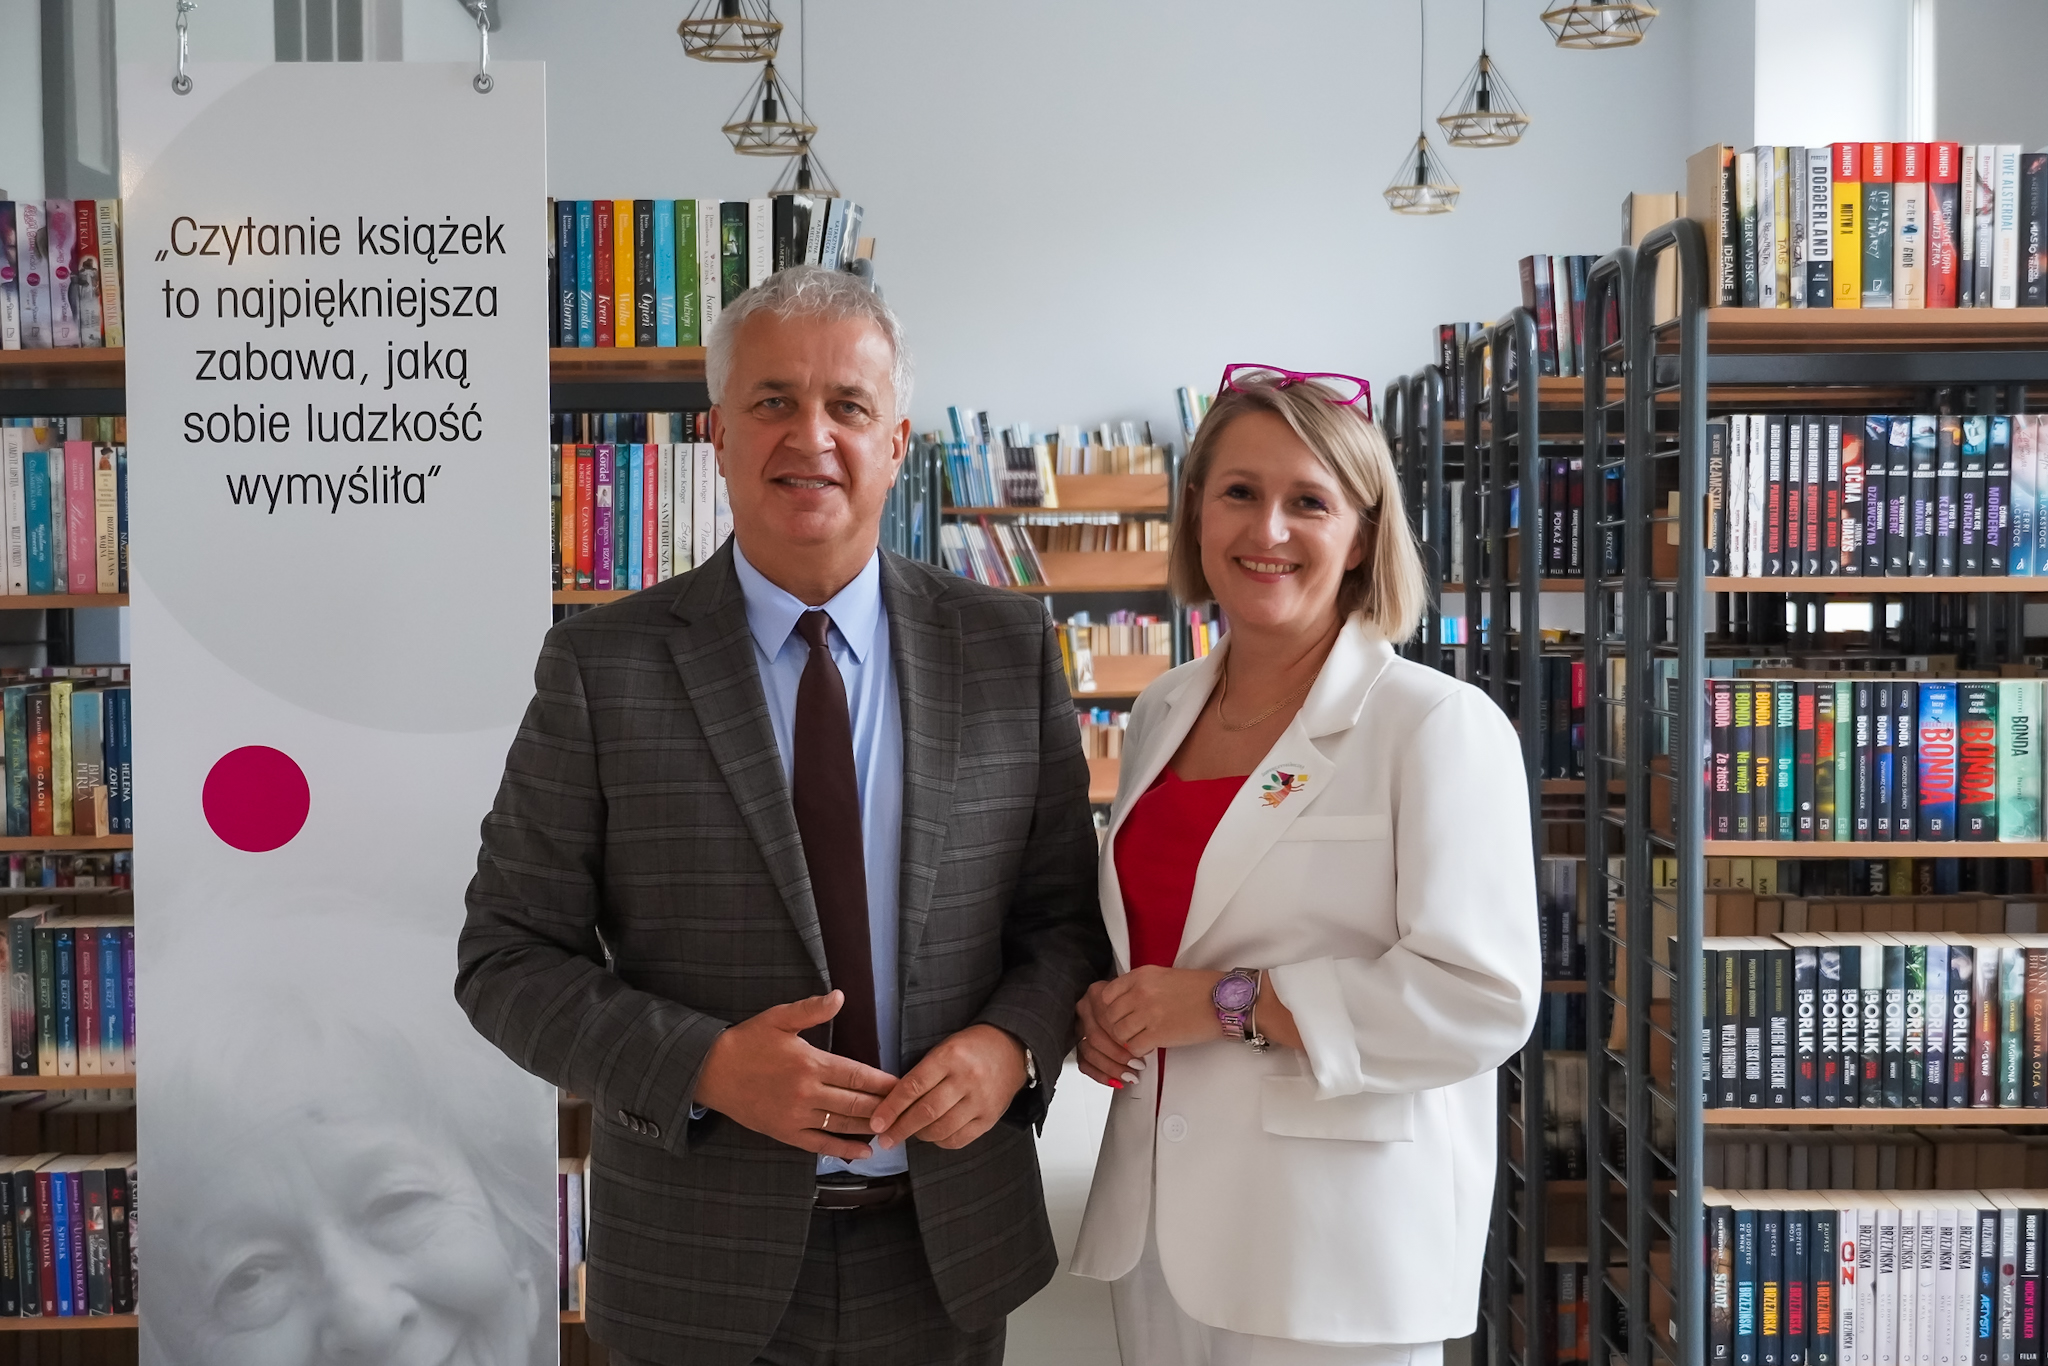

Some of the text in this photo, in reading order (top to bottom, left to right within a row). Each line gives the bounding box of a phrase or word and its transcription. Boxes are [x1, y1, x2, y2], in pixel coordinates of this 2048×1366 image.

[1812, 166, 1828, 256] DOGGERLAND
[1841, 203, 1853, 227] MOTYW
[2001, 154, 2014, 232] TOVE ALSTERDAL
[358, 215, 507, 264] książek
[757, 204, 765, 242] WĘZŁY
[830, 220, 840, 255] KATARZYNA
[102, 248, 113, 268] BERG
[1724, 245, 1734, 289] IDEALNE
[1744, 216, 1755, 285] ŻEROWISKO
[161, 278, 498, 328] to najpiękniejsza
[563, 290, 574, 330] Sztorm
[580, 290, 592, 329] Zemsta
[598, 294, 610, 326] Krew
[619, 293, 630, 326] Walka
[638, 293, 654, 328] Ogień
[660, 294, 673, 325] Mgła
[681, 291, 693, 327] Nadzieja
[705, 295, 716, 325] Koniec
[196, 341, 470, 389] zabawa, jaką
[183, 402, 483, 443] sobie ludzkość
[599, 449, 610, 482] Kordel
[1770, 424, 1780, 482] ADRIAN BEDNAREK
[1789, 425, 1800, 482] ADRIAN BEDNAREK
[1807, 424, 1819, 483] ADRIAN BEDNAREK
[1827, 424, 1838, 482] ADRIAN BEDNAREK
[679, 450, 688, 504] Theodor Kröger
[700, 450, 709, 503] Theodor Kröger
[660, 502, 669, 573] SANITARIUSZKA
[1553, 512, 1563, 559] POKAŻ MI
[1841, 518, 1856, 552] BIAŁYS
[1866, 486, 1877, 546] DZIEWCZYNA
[1889, 499, 1900, 534] ŚMIERĆ
[1915, 499, 1924, 537] UMARŁA
[1938, 496, 1949, 537] KŁAMIE
[1962, 493, 1973, 545] STRACIŁAM
[1986, 487, 1999, 546] MORDERCY
[1998, 506, 2008, 528] CÓRKA
[2012, 493, 2022, 548] BLACKSTOCK
[2022, 509, 2030, 533] TERRI
[2038, 494, 2047, 549] BLACKSTOCK
[602, 547, 610, 570] BZÓW
[1715, 692, 1730, 727] BONDA
[1735, 692, 1750, 727] BONDA
[1756, 692, 1770, 727] BONDA
[1778, 692, 1793, 727] BONDA
[1799, 695, 1813, 730] BONDA
[1837, 693, 1849, 723] BONDA
[1818, 722, 1833, 757] BONDA
[1856, 715, 1867, 747] BONDA
[1877, 715, 1887, 747] BONDA
[1898, 715, 1909, 747] BONDA
[2011, 716, 2028, 757] BONDA
[109, 767, 118, 798] ZOFIA
[122, 763, 130, 802] HELENA
[1716, 753, 1729, 792] Ze złości
[1734, 751, 1749, 793] Na uwięzi
[1756, 766, 1769, 787] włos
[1778, 758, 1791, 787] Do cna
[1859, 755, 1867, 792] KOLEKCJONER
[1920, 729, 1954, 805] BONDA
[1960, 728, 1994, 805] BONDA
[37, 766, 45, 812] OCALONE
[2029, 955, 2037, 993] BRAUN
[2038, 955, 2047, 994] DANKA
[1798, 994, 1813, 1053] BORLIK
[1823, 994, 1837, 1053] BORLIK
[1842, 994, 1857, 1053] BORLIK
[1864, 994, 1878, 1054] BORLIK
[1885, 994, 1901, 1052] BORLIK
[1906, 994, 1922, 1052] BORLIK
[1927, 994, 1943, 1052] BORLIK
[1953, 994, 1968, 1053] BORLIK
[2032, 999, 2041, 1087] EGZAMIN NA OJCA
[1721, 1024, 1736, 1079] WIEŻA STRACHU
[1744, 1028, 1760, 1079] DIABELSKI KRĄG
[1770, 1017, 1787, 1089] ŚMIERĆ NIE UCIEKNIE
[58, 1226, 66, 1260] SPISEK
[73, 1222, 84, 1297] UCIEKINIERZY
[1859, 1225, 1873, 1269] BRZEZIŃSKA
[1879, 1226, 1897, 1274] BRZEZIŃSKA
[1901, 1226, 1915, 1270] BRZEZIŃSKA
[1920, 1226, 1935, 1270] BRZEZIŃSKA
[1939, 1227, 1955, 1270] BRZEZIŃSKA
[1959, 1226, 1974, 1270] BRZEZIŃSKA
[1981, 1218, 1995, 1258] BRZEZIŃSKA
[2025, 1215, 2036, 1272] ROBERT BRYNDZA
[1714, 1273, 1728, 1308] SZADŹ
[1738, 1287, 1754, 1335] BRZEZIŃSKA
[1763, 1287, 1778, 1335] BRZEZIŃSKA
[1789, 1287, 1803, 1335] BRZEZIŃSKA
[1816, 1287, 1832, 1334] BRZEZIŃSKA
[2002, 1285, 2012, 1339] WIZJONER
[2023, 1281, 2034, 1339] NOCNY STALKER
[1843, 1312, 1854, 1350] BRZEZIŃSKA
[1979, 1294, 1990, 1338] ARTYSTA
